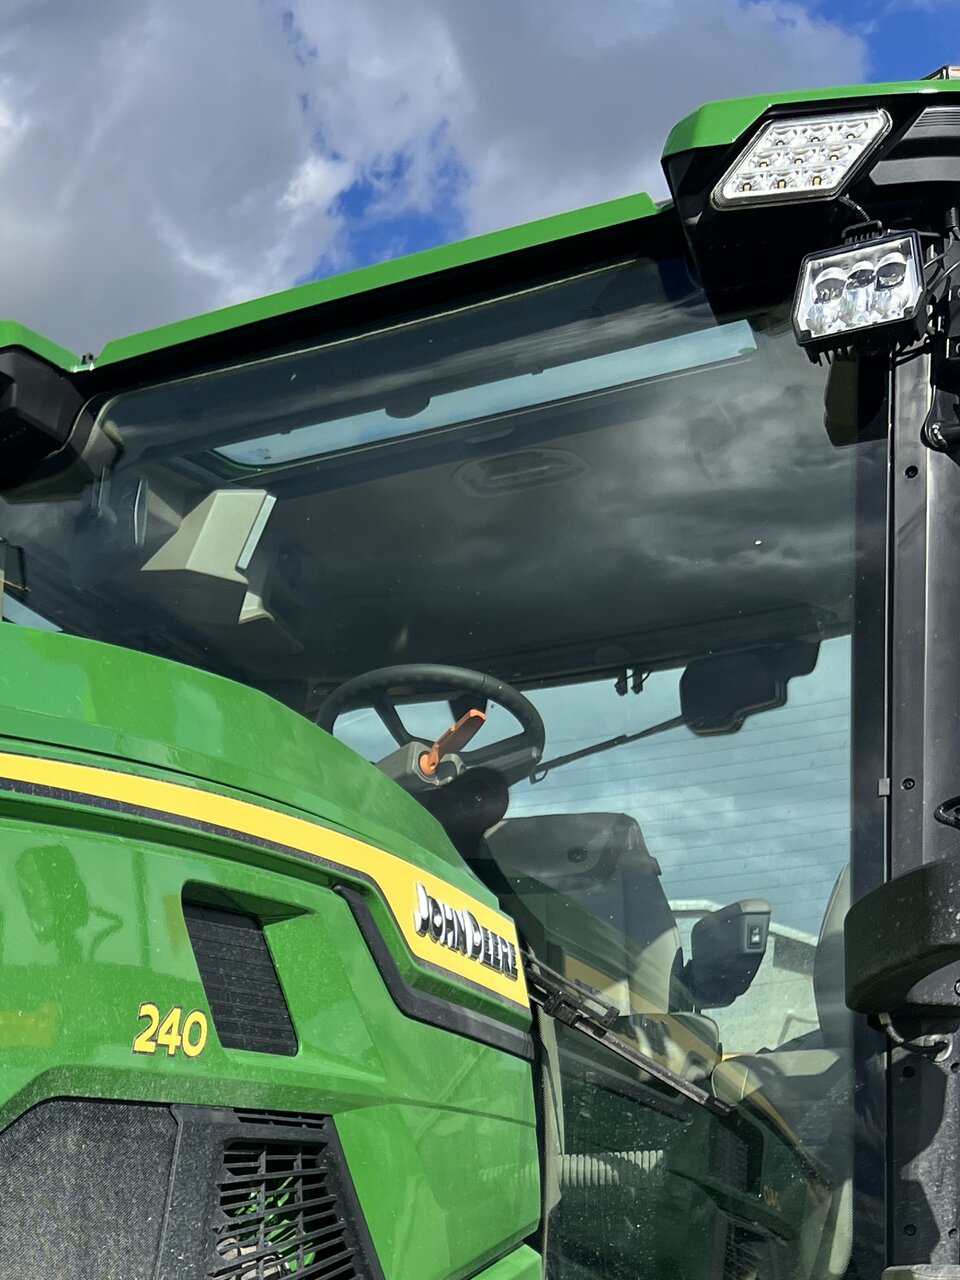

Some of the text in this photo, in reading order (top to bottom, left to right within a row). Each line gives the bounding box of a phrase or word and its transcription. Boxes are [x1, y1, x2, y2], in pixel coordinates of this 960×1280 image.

[414, 881, 518, 982] JOHN DEERE
[132, 1003, 208, 1058] 240
